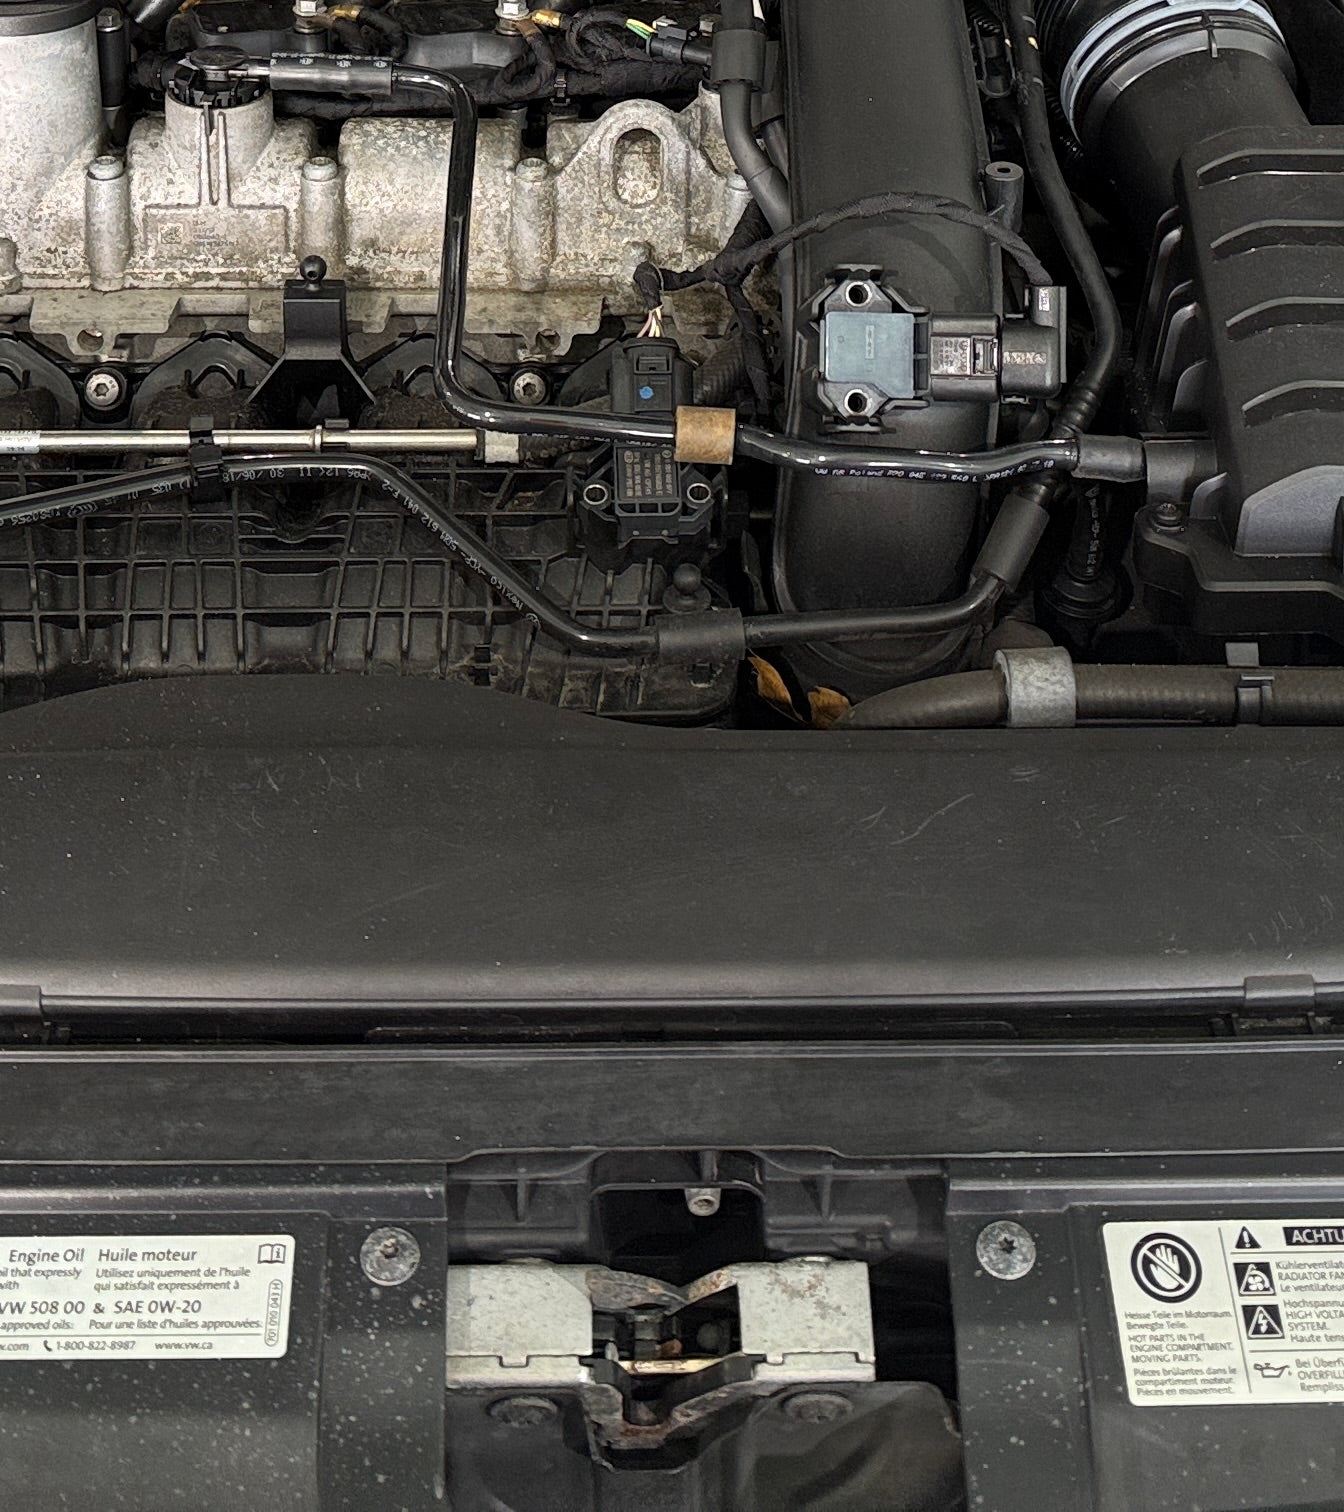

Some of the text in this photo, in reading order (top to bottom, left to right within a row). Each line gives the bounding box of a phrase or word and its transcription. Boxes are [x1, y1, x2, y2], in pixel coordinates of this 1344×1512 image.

[8, 1247, 85, 1266] Engine Oil
[98, 1248, 198, 1262] Huile moteur
[10, 1267, 32, 1277] that
[33, 1267, 82, 1279] expressly
[95, 1267, 251, 1280] Utilisez uniquement de l'huile
[1277, 1271, 1327, 1281] RADIATOR
[93, 1279, 240, 1293] qui satisfait expressément à
[1280, 1284, 1291, 1293] Le
[29, 1300, 60, 1315] 508
[63, 1300, 86, 1314] 00
[93, 1302, 105, 1314] &
[113, 1300, 144, 1314] SAE
[147, 1299, 202, 1314] 0W-20
[1285, 1310, 1313, 1320] HIGH
[0, 1319, 51, 1332] approved
[89, 1319, 113, 1330] Pour
[114, 1320, 134, 1330] une
[136, 1319, 158, 1330] liste
[159, 1318, 199, 1330] d'huiles
[56, 1340, 136, 1351] 1-800-822-8987
[154, 1340, 213, 1350] www.vw.ca
[1295, 1358, 1311, 1368] Bei
